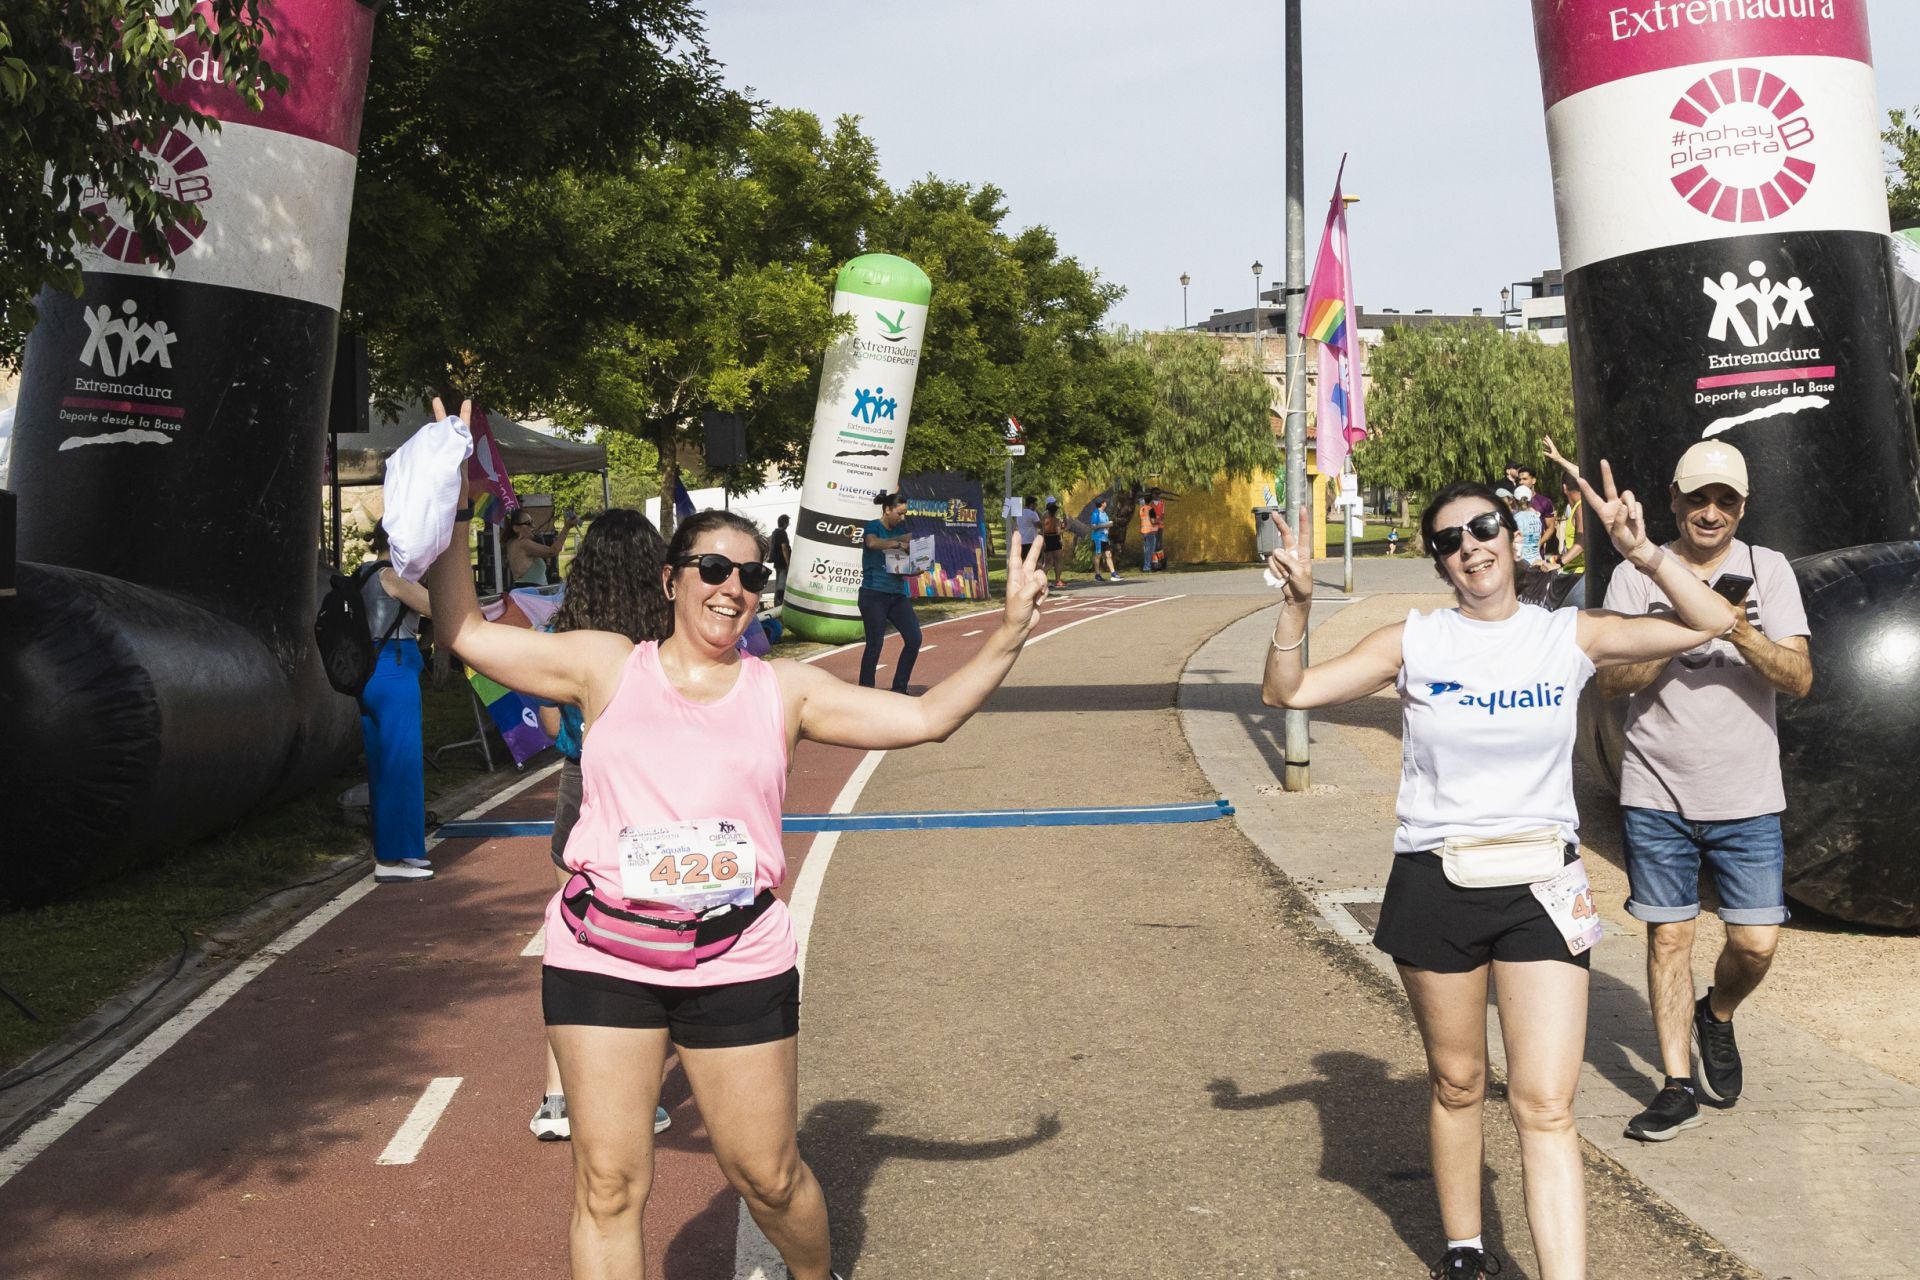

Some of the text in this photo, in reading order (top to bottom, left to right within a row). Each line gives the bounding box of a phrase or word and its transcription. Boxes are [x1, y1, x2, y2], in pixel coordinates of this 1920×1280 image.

[1609, 0, 1835, 41] Extremadura
[1671, 124, 1774, 147] #nohay
[1777, 117, 1814, 150] B
[1670, 140, 1779, 168] planeta
[175, 175, 213, 204] B
[853, 337, 918, 358] Extremadura
[1708, 348, 1821, 369] Extremadura
[75, 378, 173, 399] Extremadura
[1695, 381, 1835, 405] Deporte desde la Base
[59, 409, 182, 431] Deporte desde la Base
[847, 422, 894, 436] Extremadura
[846, 468, 873, 477] DEPORTES
[815, 521, 865, 539] euroa
[649, 851, 739, 886] 426
